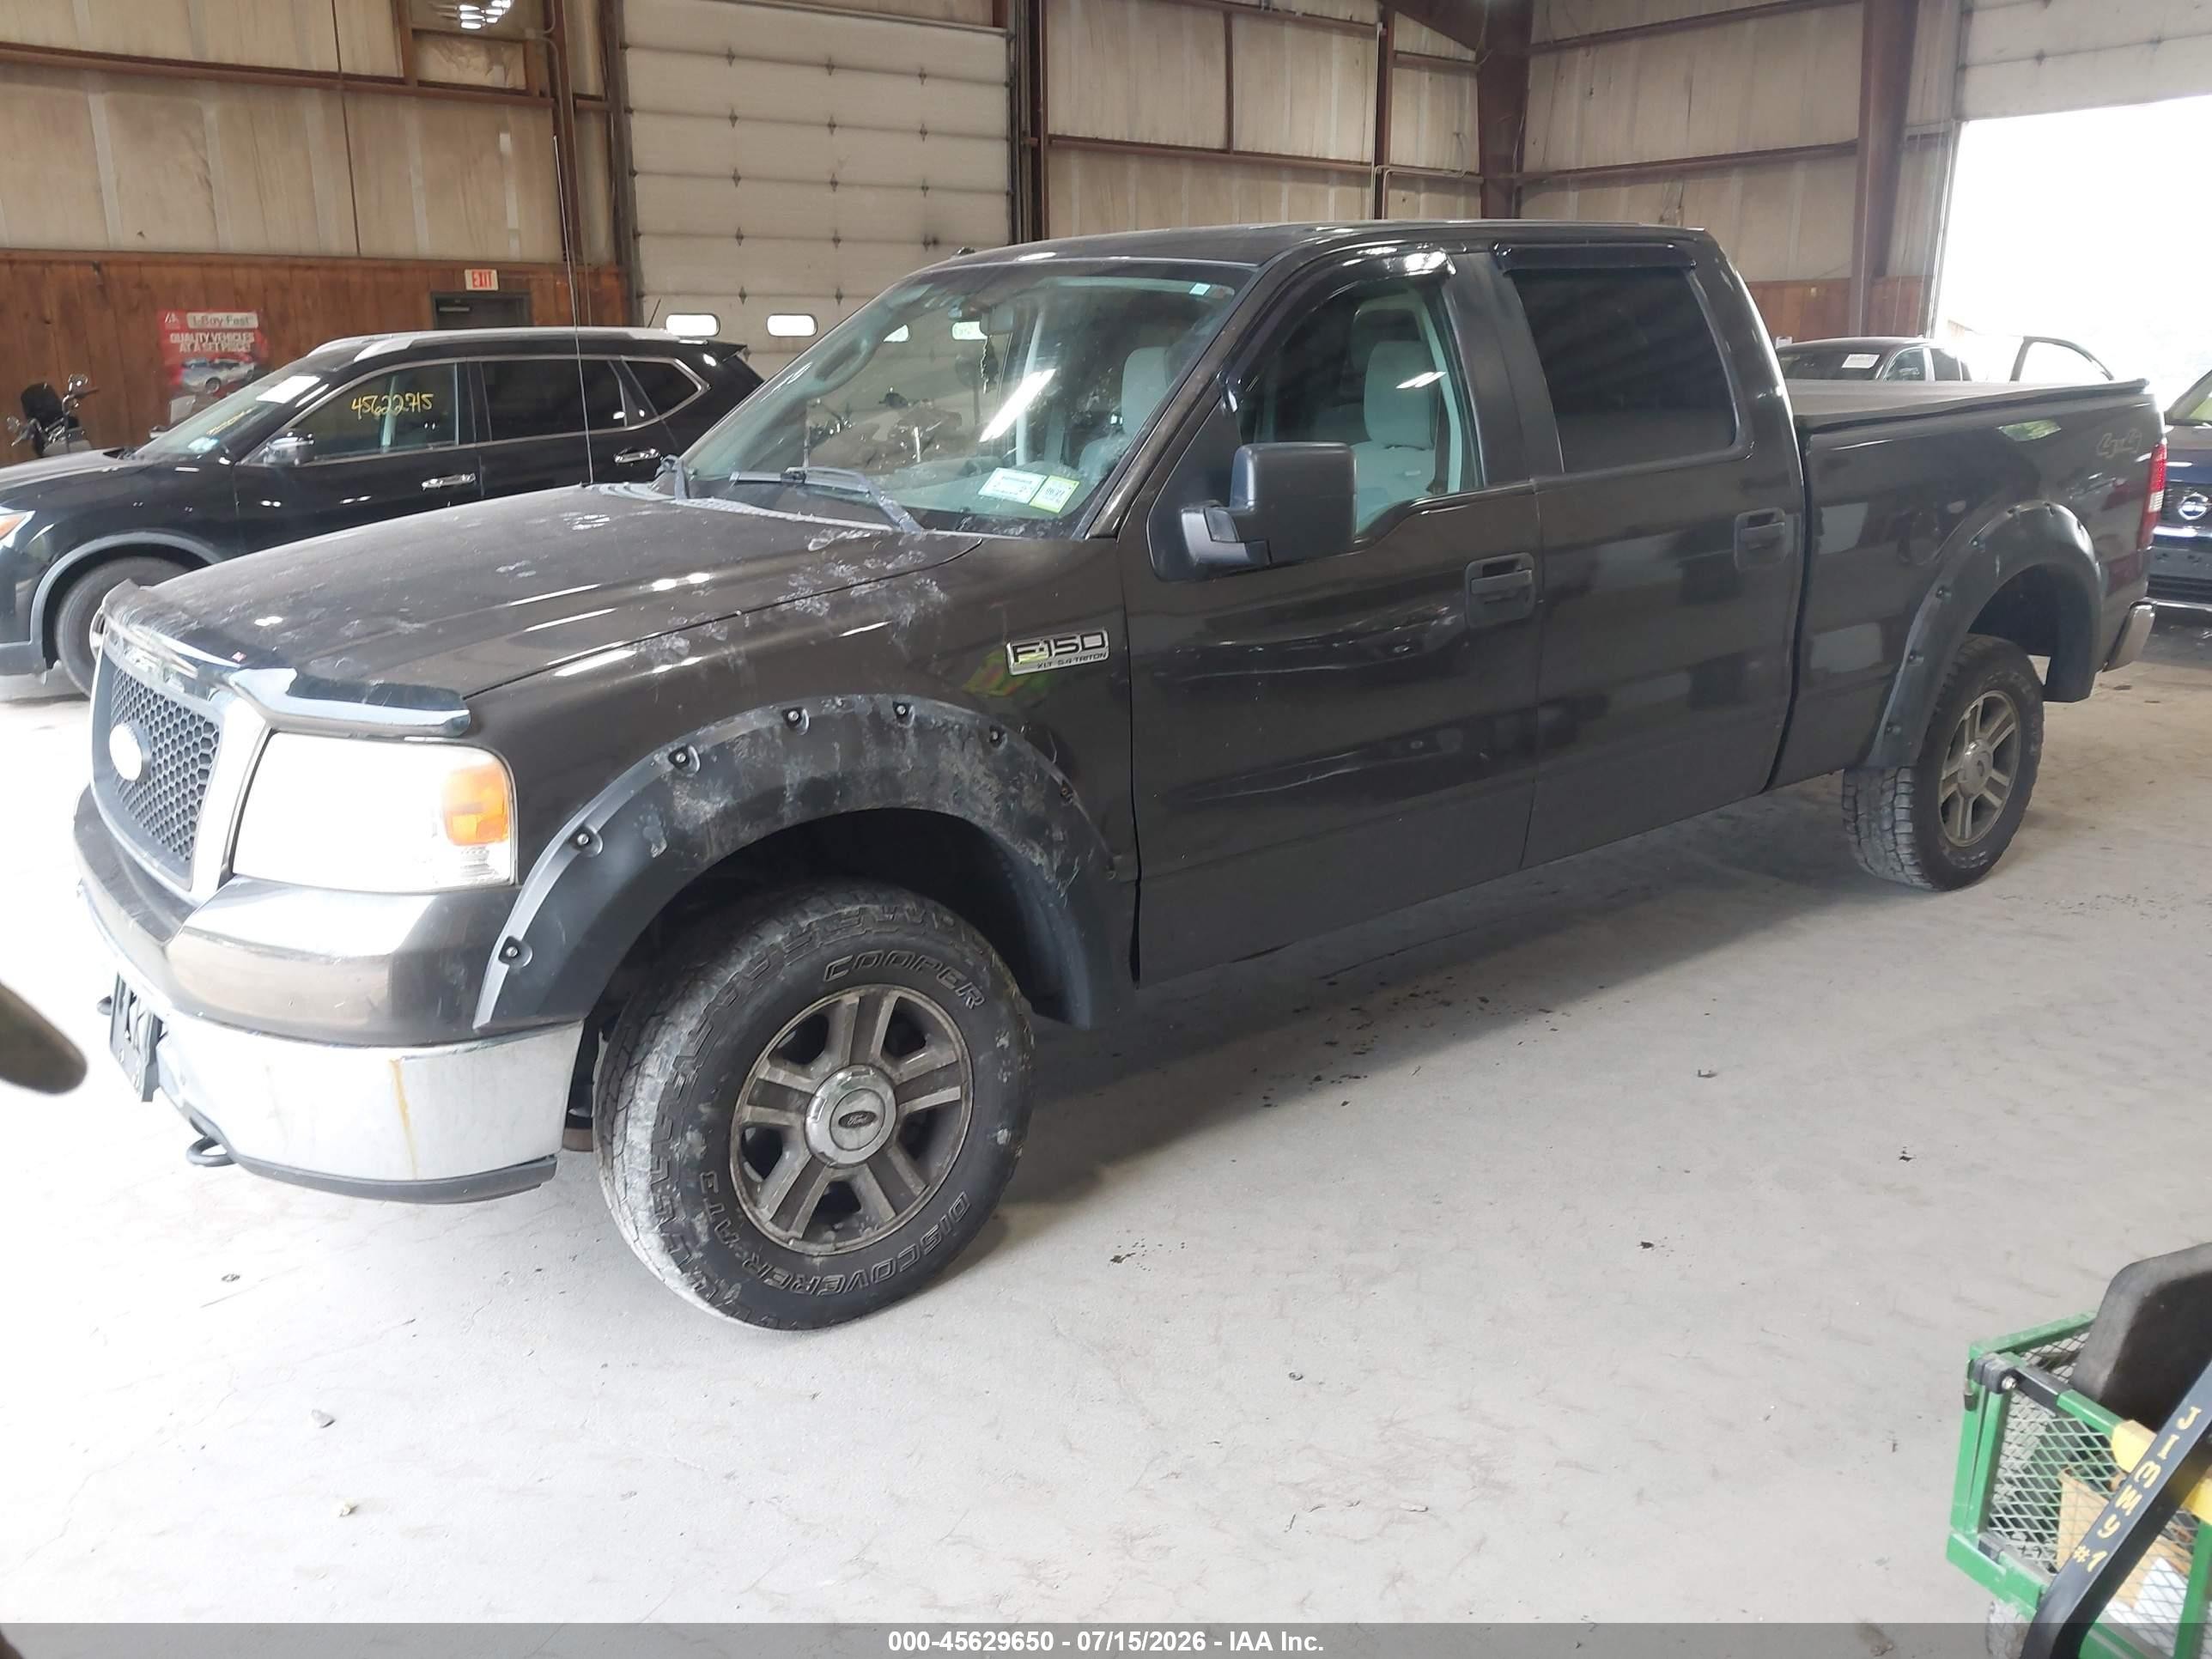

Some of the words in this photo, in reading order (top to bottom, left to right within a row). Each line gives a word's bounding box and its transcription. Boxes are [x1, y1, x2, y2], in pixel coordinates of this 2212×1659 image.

[472, 270, 493, 289] EXIT
[170, 331, 210, 343] QUALITY
[211, 331, 255, 343] VEHICLES
[179, 343, 191, 353] AT
[193, 343, 201, 353] A
[203, 343, 219, 353] SET
[823, 950, 986, 1010] COOPER
[700, 1170, 741, 1245] AT3
[742, 1191, 971, 1297] DISCOVERER
[2073, 1546, 2108, 1573] #1
